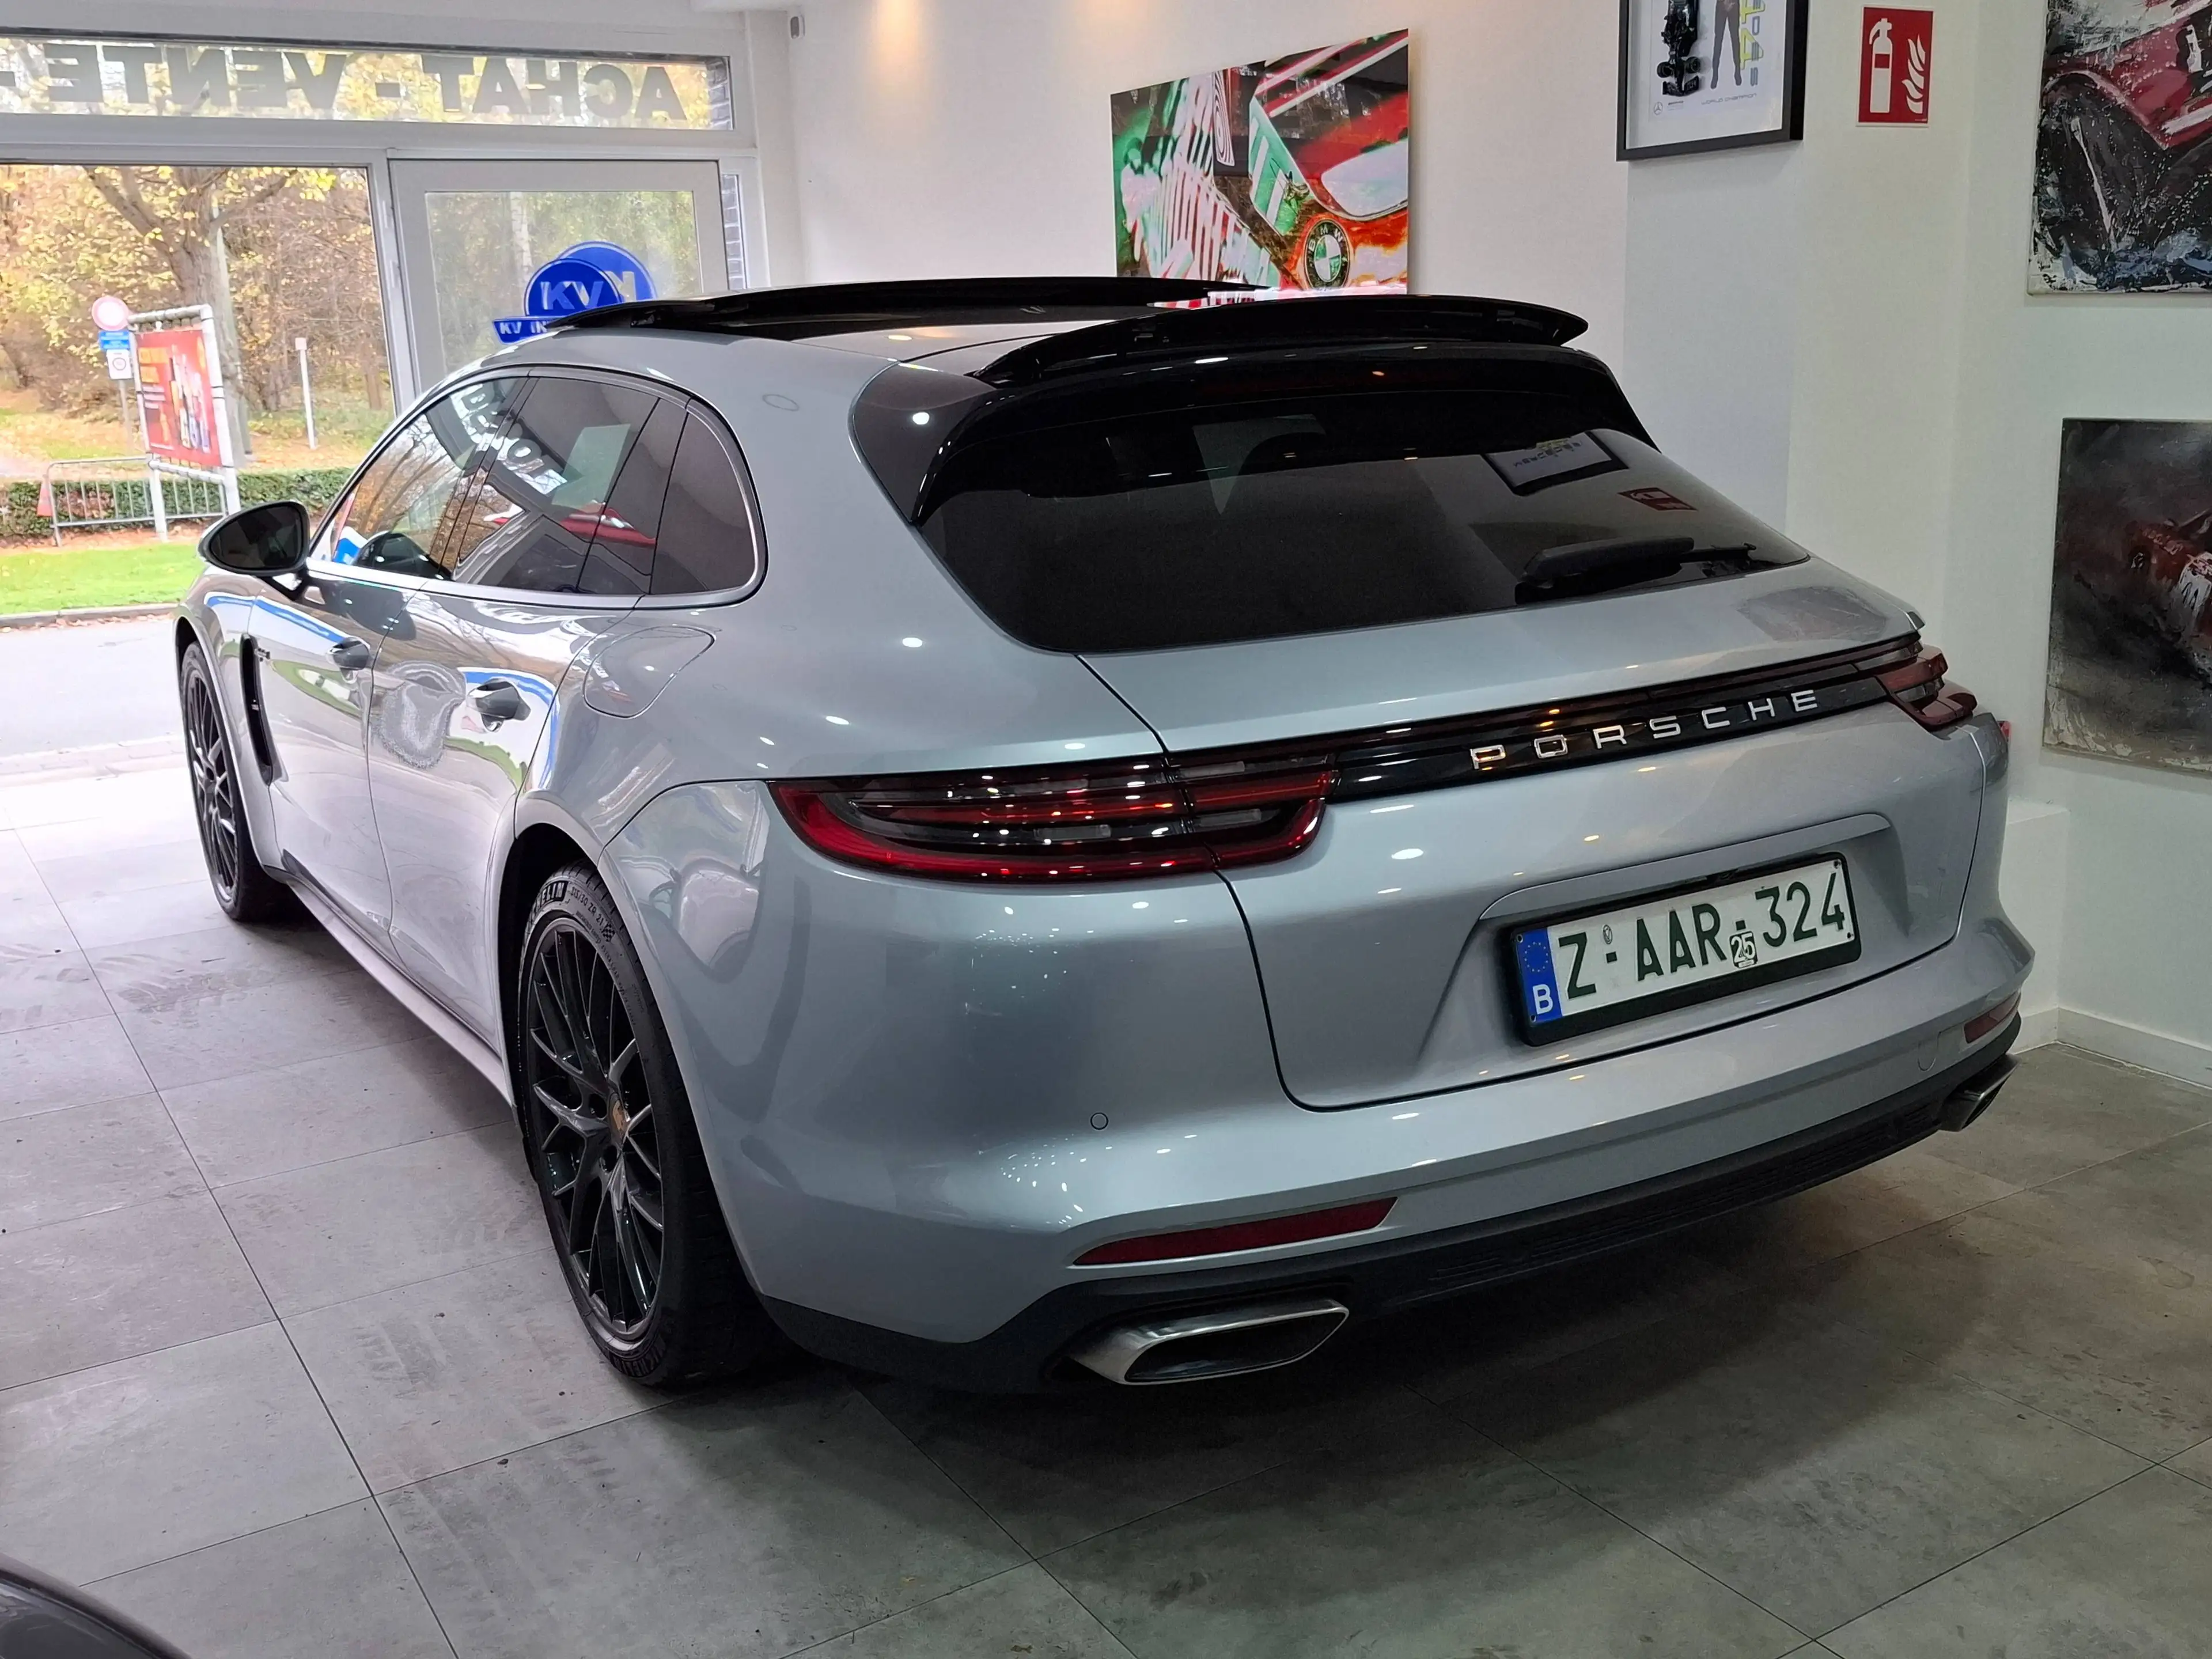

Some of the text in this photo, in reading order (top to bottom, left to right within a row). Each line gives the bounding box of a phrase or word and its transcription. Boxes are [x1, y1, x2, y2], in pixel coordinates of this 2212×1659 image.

[1309, 224, 1344, 252] BMW
[540, 280, 604, 310] KV
[499, 321, 522, 334] KV
[1470, 690, 1818, 770] PORSCHE
[1731, 933, 1756, 963] 25
[1532, 983, 1554, 1015] B
